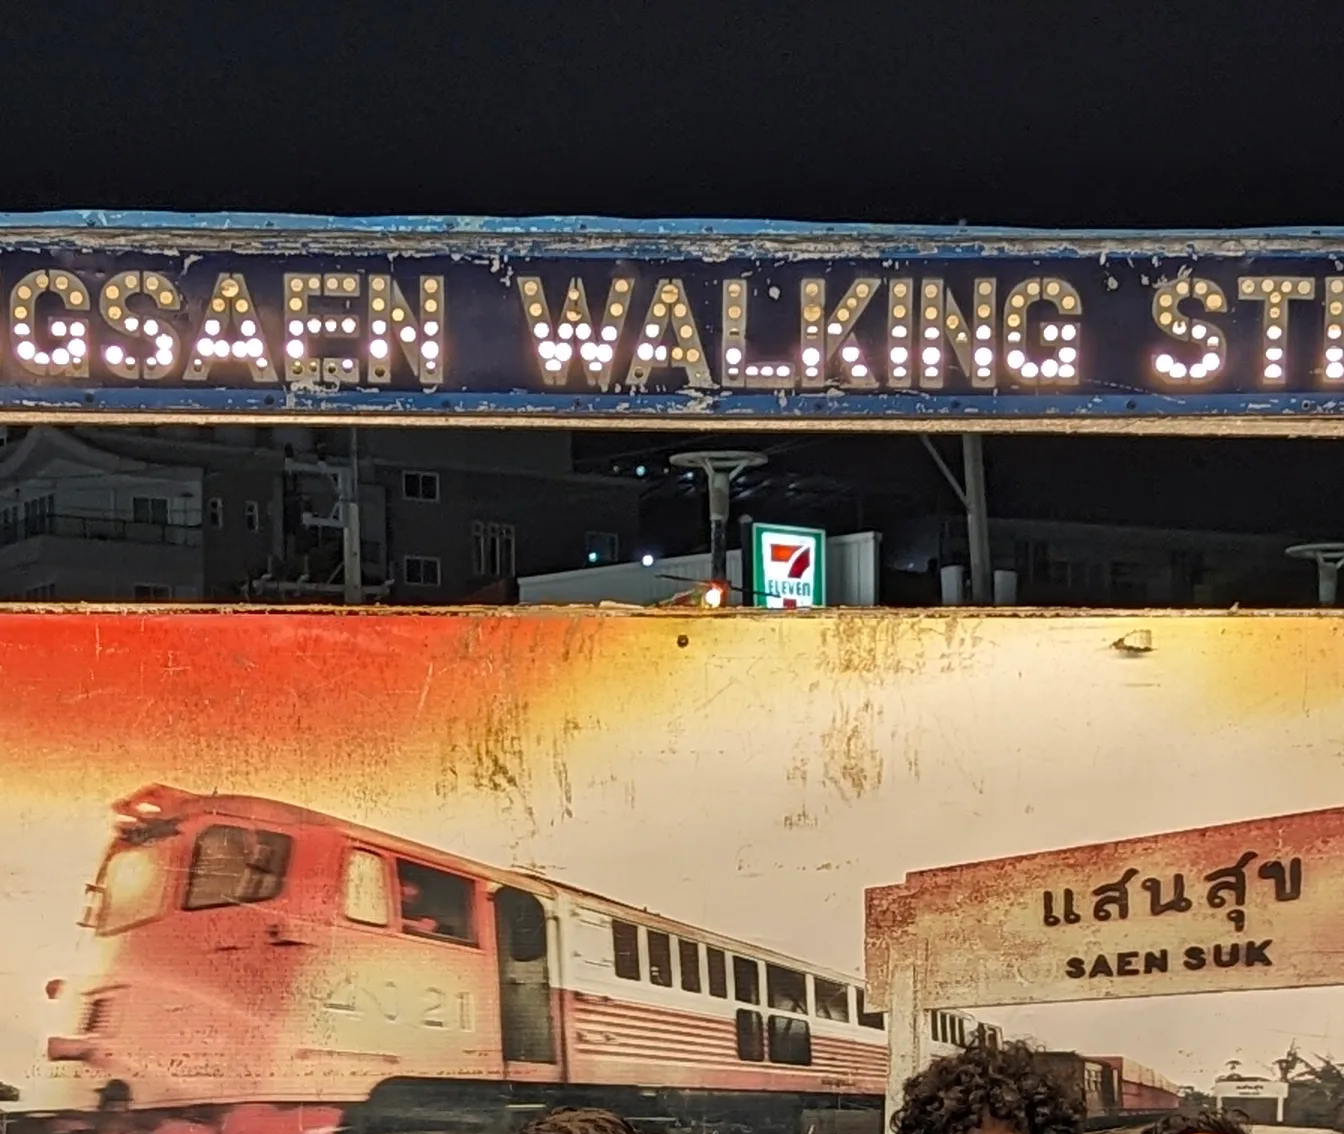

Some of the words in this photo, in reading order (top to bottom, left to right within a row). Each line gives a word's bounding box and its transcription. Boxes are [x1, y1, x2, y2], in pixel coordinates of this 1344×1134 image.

[517, 274, 1082, 390] WALKING
[1042, 851, 1304, 933] แสนสุข
[1065, 949, 1169, 980] SAEN
[1182, 938, 1273, 970] SUK
